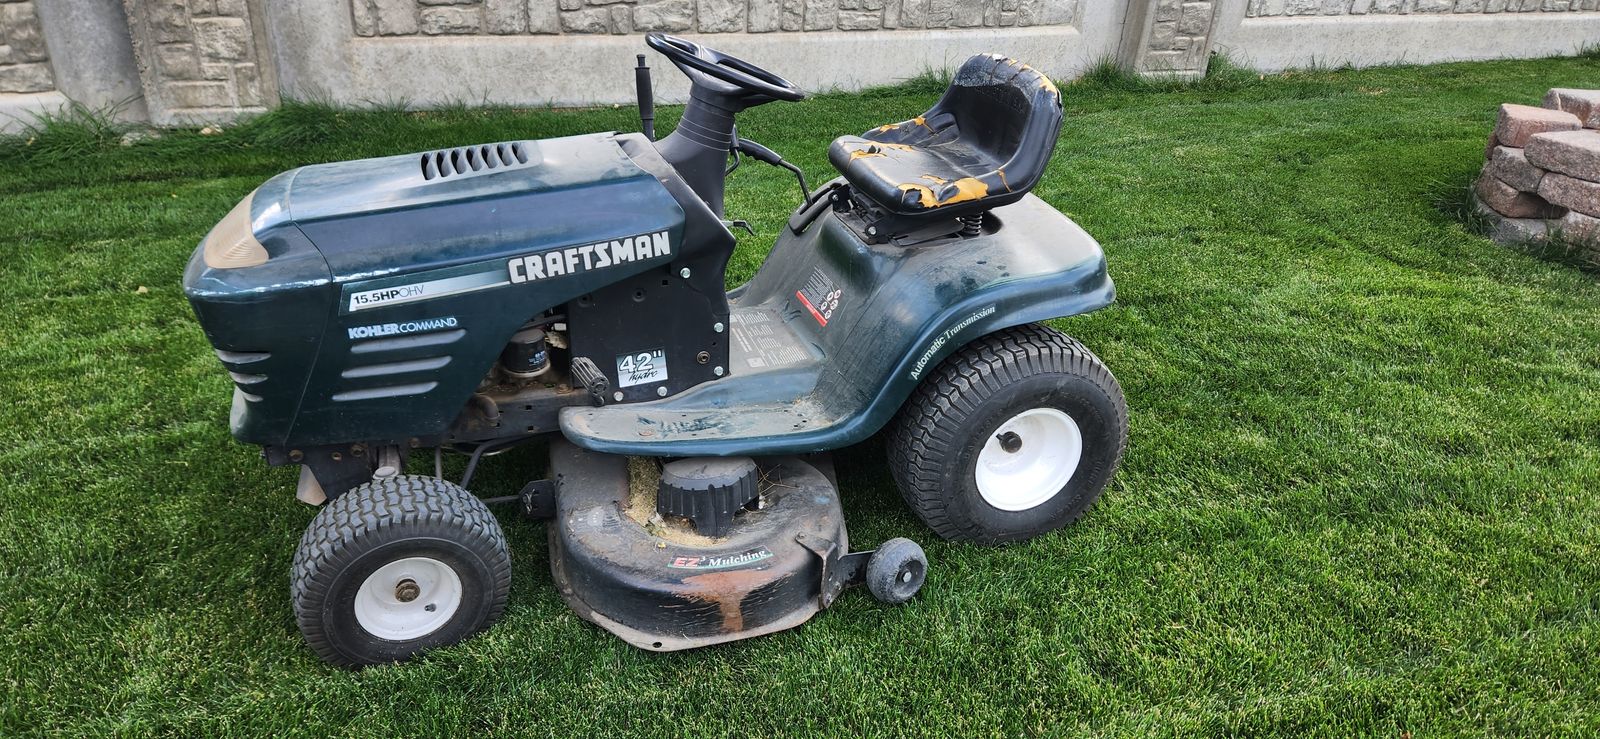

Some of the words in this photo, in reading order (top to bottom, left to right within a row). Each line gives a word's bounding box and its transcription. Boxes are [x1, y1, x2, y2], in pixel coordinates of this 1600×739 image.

[508, 231, 671, 284] CRAFTSMAN
[910, 336, 946, 380] Automatic
[944, 305, 996, 340] Transmission
[708, 550, 767, 567] Mulching
